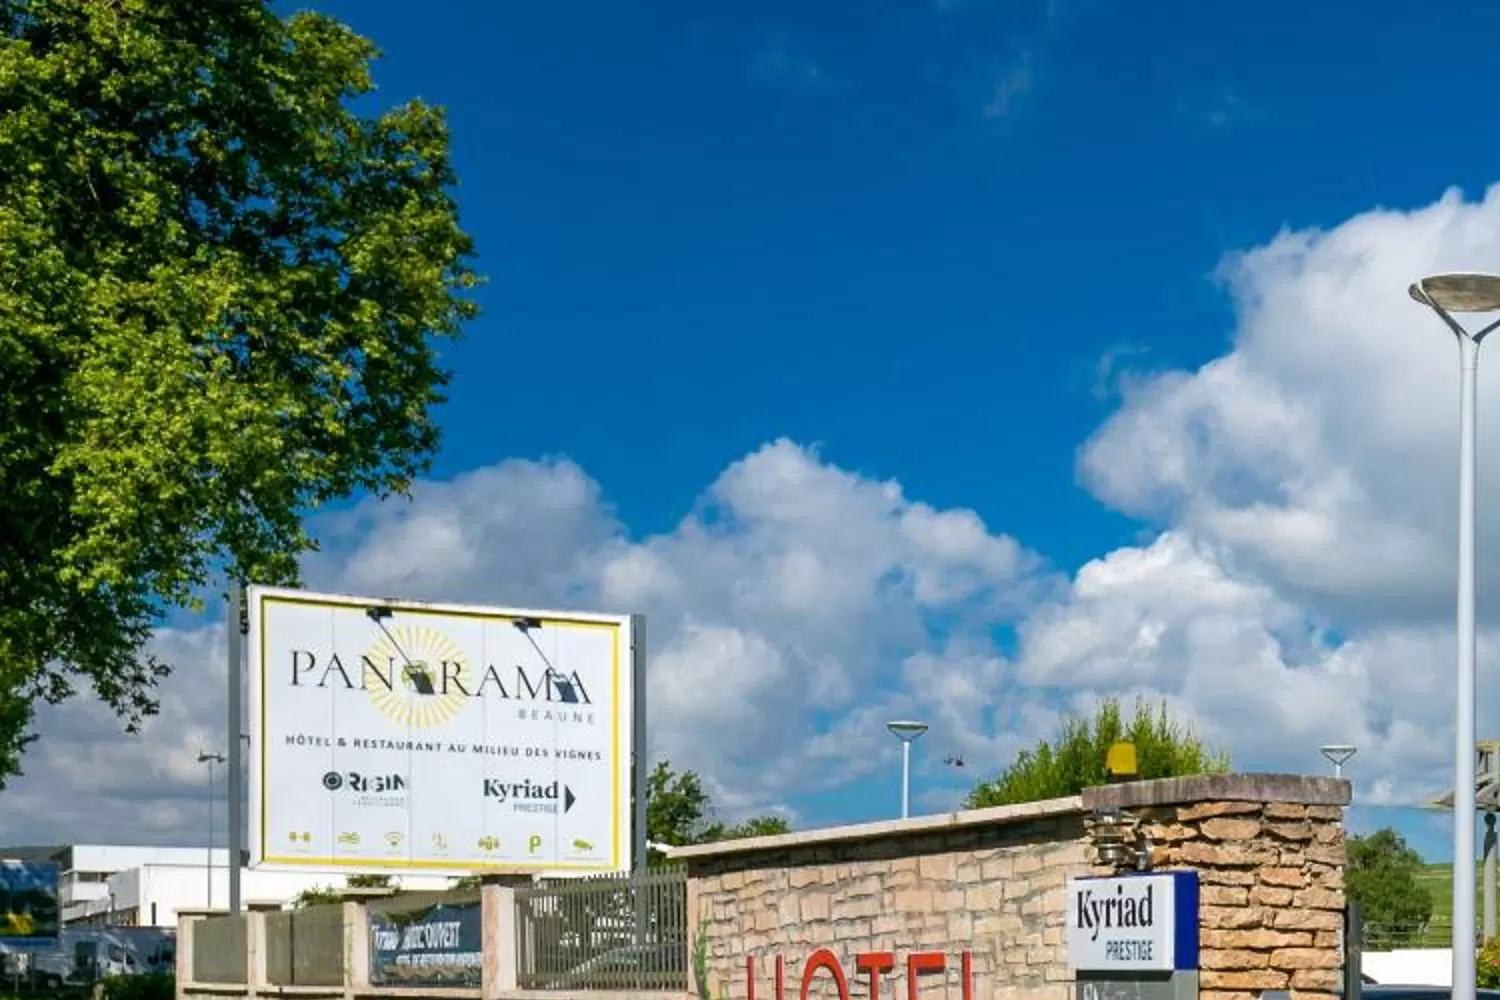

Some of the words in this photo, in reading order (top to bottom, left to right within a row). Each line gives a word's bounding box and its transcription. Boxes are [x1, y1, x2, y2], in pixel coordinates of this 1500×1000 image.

[517, 708, 596, 726] BEAUNE
[285, 732, 331, 748] HÔTEL
[337, 736, 347, 748] &
[353, 738, 442, 753] RESTAURANT
[448, 743, 467, 754] AU
[472, 744, 519, 757] MILIEU
[525, 747, 549, 759] DES
[555, 751, 602, 762] VIGNES
[483, 777, 559, 804] Kyriad
[1077, 883, 1153, 942] Kyriad
[1105, 939, 1153, 961] PRESTIGE
